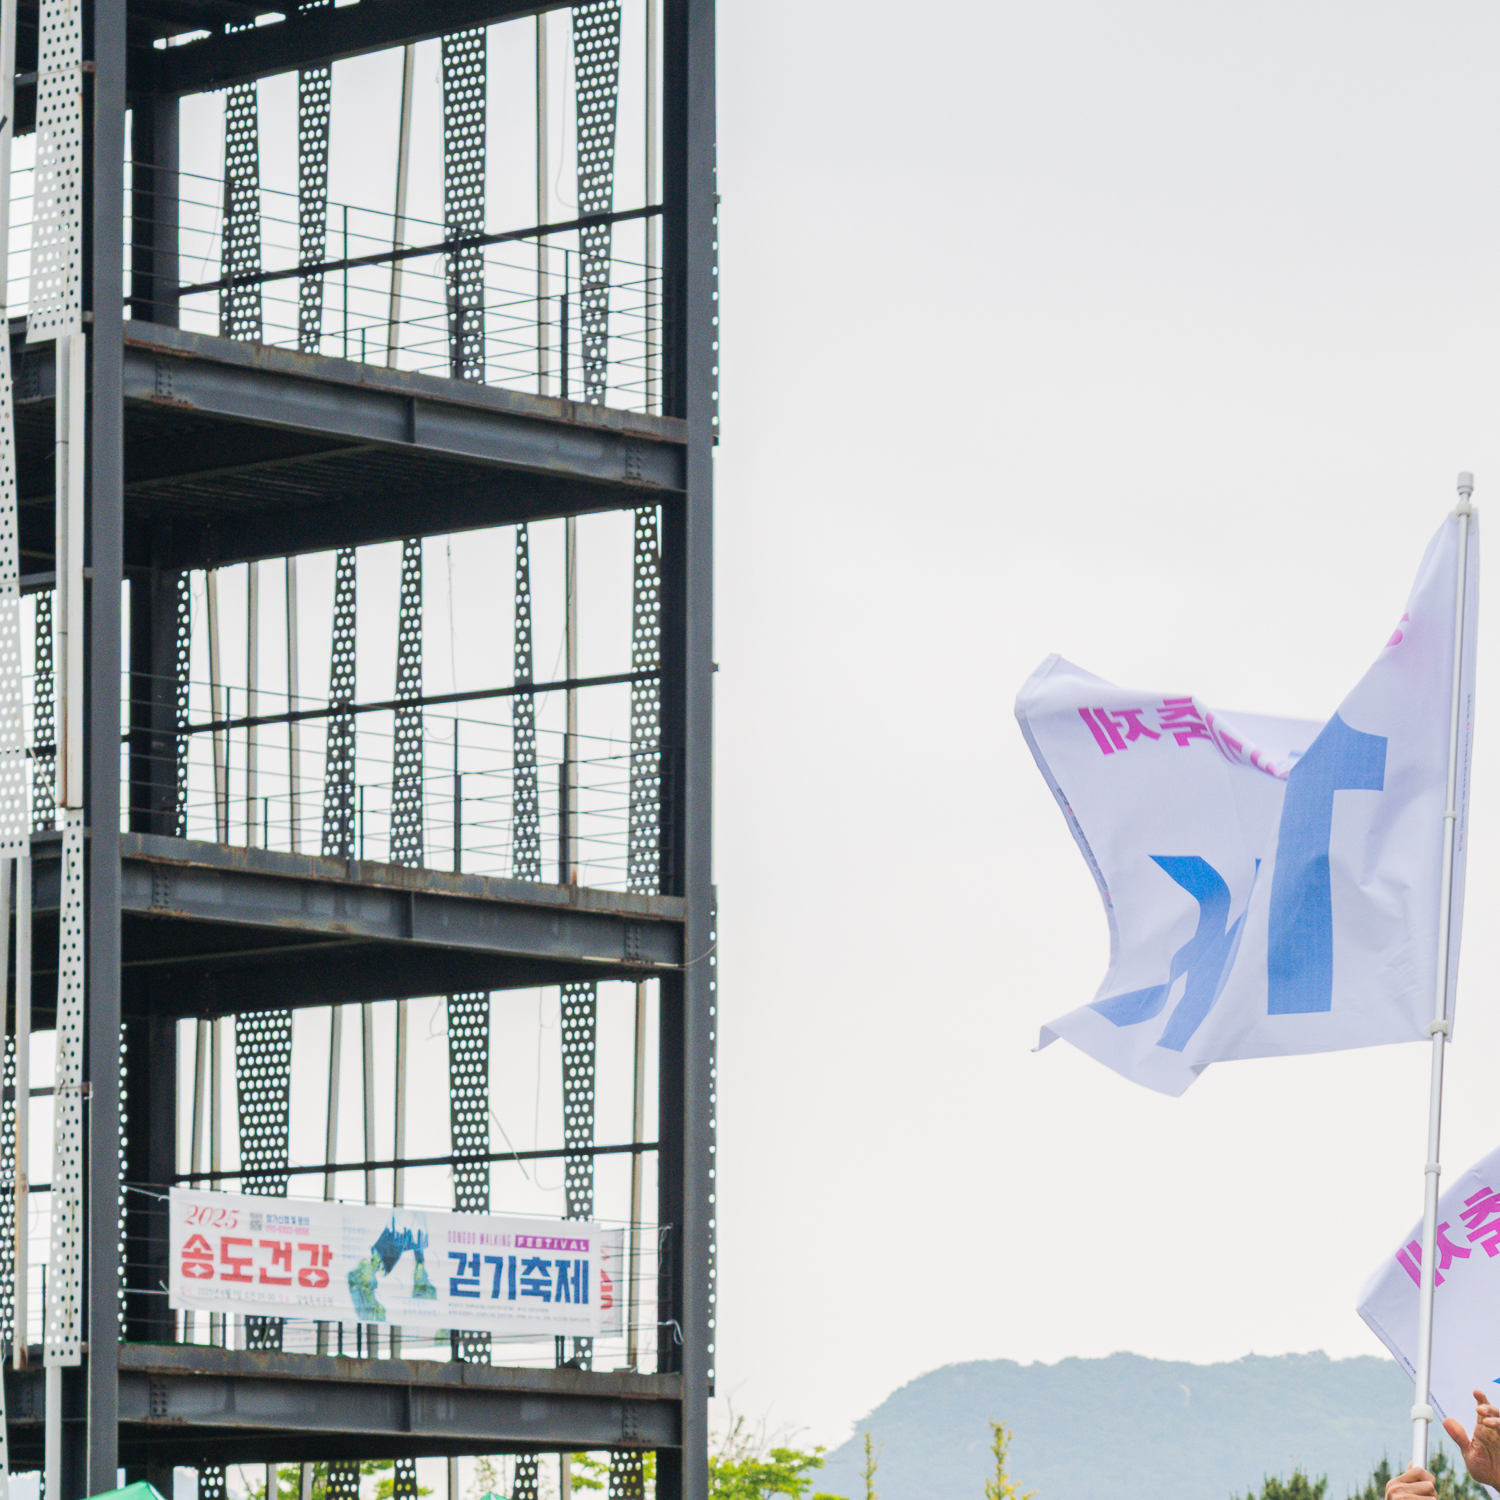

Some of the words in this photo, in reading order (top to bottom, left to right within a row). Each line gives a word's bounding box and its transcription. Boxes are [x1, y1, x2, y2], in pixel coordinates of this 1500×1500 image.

[185, 1205, 240, 1230] 2025
[516, 1235, 588, 1252] FESTIVAL
[181, 1233, 333, 1289] 송도건강
[448, 1251, 589, 1305] 걷기축제
